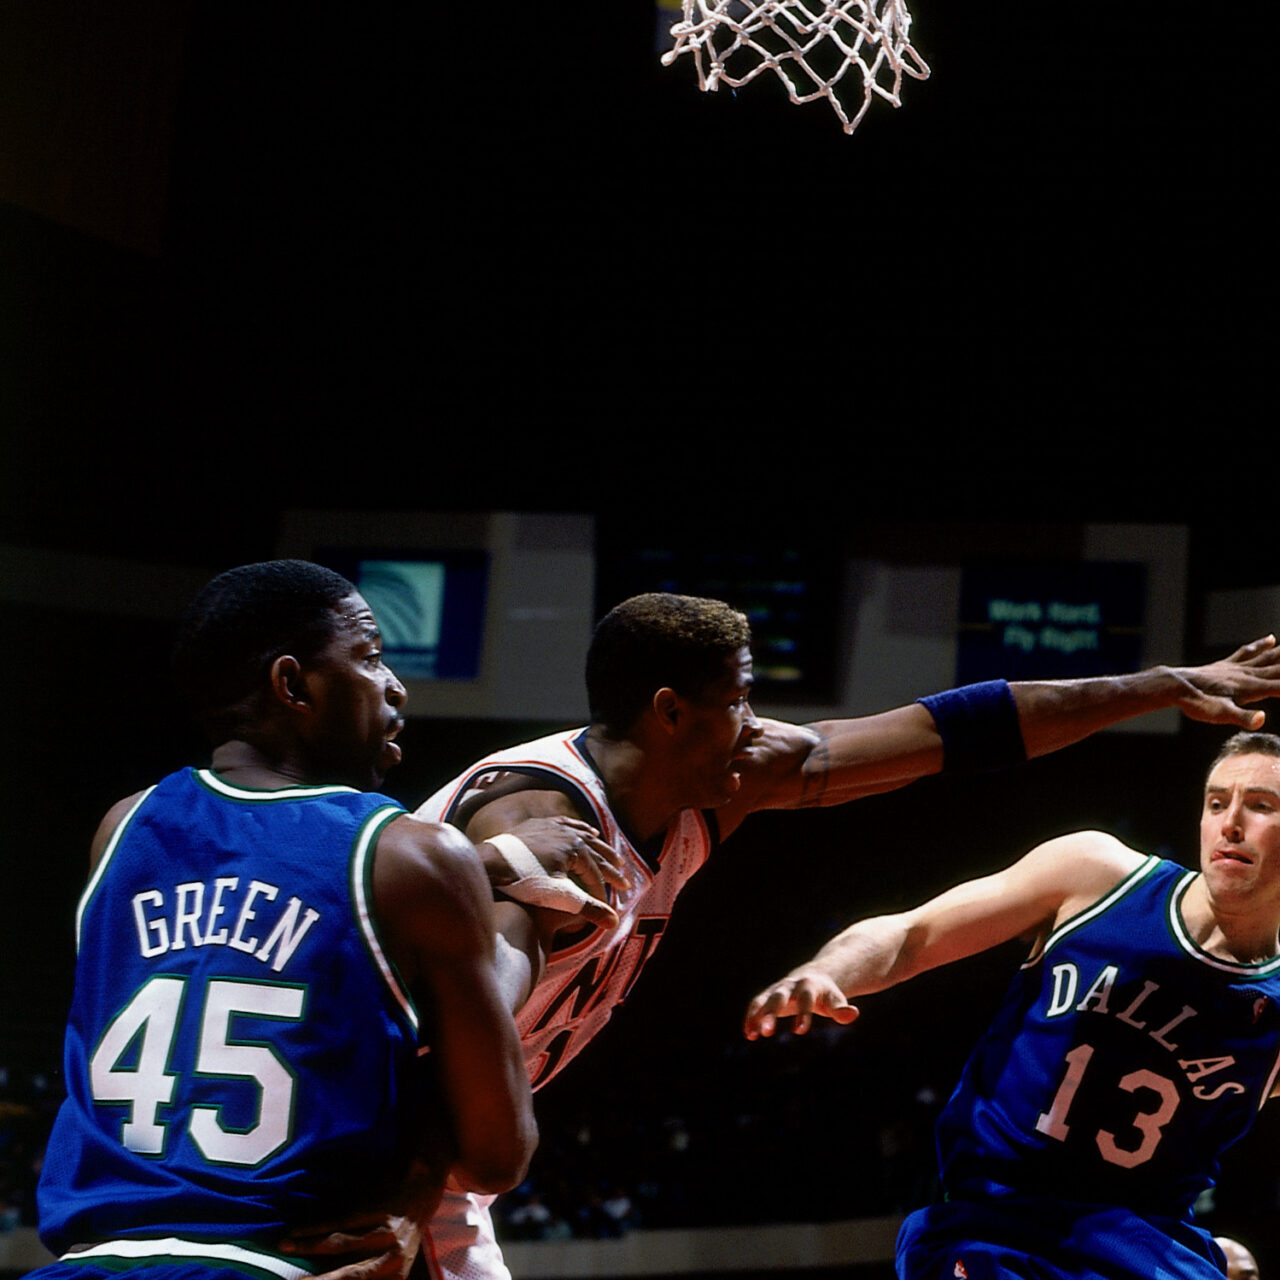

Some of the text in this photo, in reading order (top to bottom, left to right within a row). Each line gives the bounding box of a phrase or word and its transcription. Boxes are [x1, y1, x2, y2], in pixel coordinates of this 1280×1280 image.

[131, 876, 321, 973] GREEN
[90, 973, 309, 1167] 45
[1046, 962, 1246, 1101] DALLAS
[1035, 1043, 1181, 1169] 13
